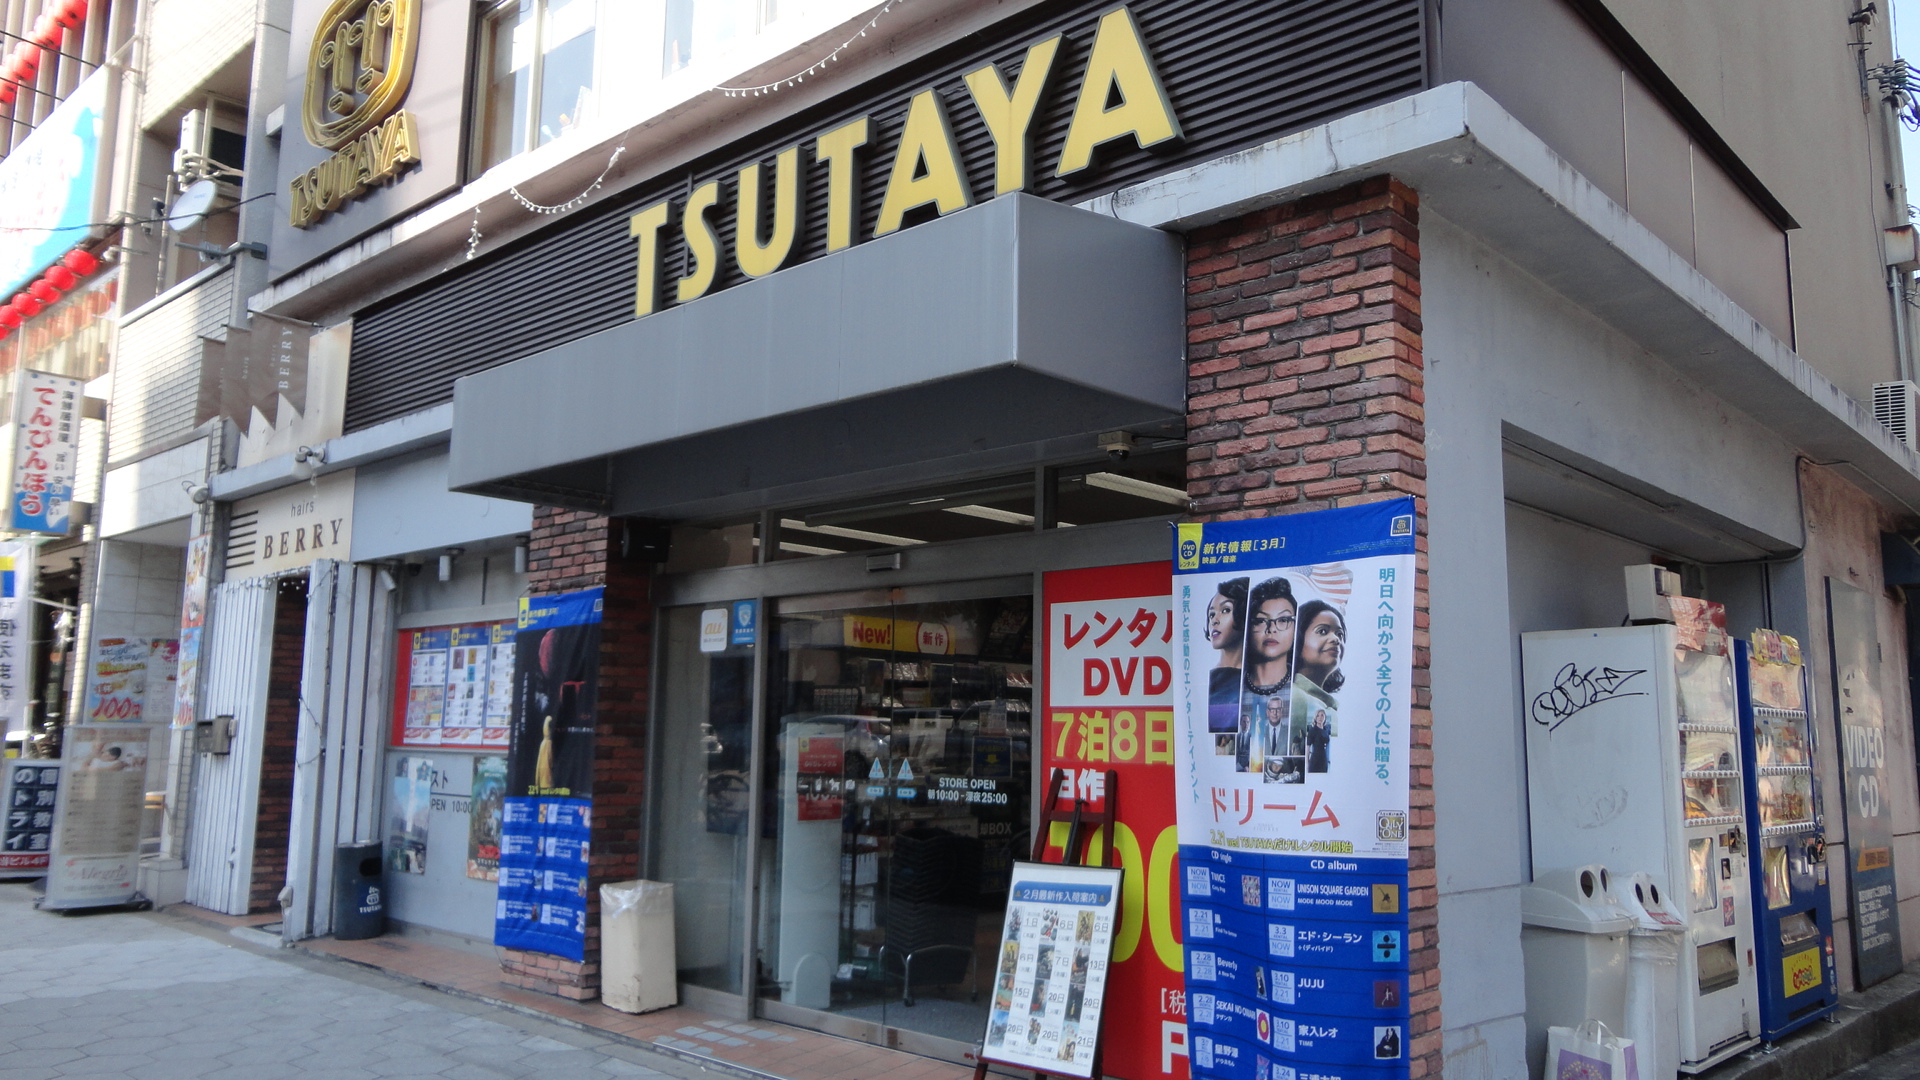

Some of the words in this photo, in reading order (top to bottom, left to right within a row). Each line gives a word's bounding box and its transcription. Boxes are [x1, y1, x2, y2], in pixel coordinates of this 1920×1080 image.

[629, 5, 1186, 319] TSUTAYA
[289, 108, 421, 230] TSUTAYA
[278, 326, 293, 389] BERRY
[290, 501, 315, 517] hairs
[262, 518, 343, 560] BERRY
[1202, 536, 1287, 555] 新作情報[3月]
[1180, 560, 1196, 568] レンタル
[852, 621, 892, 645] New!
[922, 631, 944, 646] 新作
[1083, 655, 1172, 696] DVD
[1051, 710, 1174, 765] 7泊8日
[1843, 724, 1885, 769] VIDEO
[938, 777, 968, 789] STORE
[969, 778, 996, 790] OPEN
[1857, 775, 1880, 819] CD
[431, 798, 446, 811] PEN
[1211, 786, 1341, 829] ドリーム
[1382, 829, 1403, 839] ONE
[1190, 868, 1207, 876] NOW
[1310, 860, 1326, 869] CD
[1327, 861, 1358, 871] album
[1271, 880, 1291, 889] NOW
[1297, 883, 1319, 894] UNISON
[1320, 884, 1344, 896] SQUARE
[1344, 886, 1369, 896] GARDEN
[1271, 895, 1291, 904] NOW
[1194, 910, 1208, 918] 2.21
[1094, 922, 1109, 933] 6日
[1274, 926, 1287, 935] 3.3
[1297, 930, 1363, 943] エド・シーラン
[1271, 942, 1291, 951] NOW
[1217, 957, 1238, 971] Beverly
[1274, 973, 1290, 983] 3.10
[1297, 978, 1325, 989] JUJU
[1048, 992, 1065, 1003] 20日
[1083, 998, 1101, 1009] 20日
[1216, 1000, 1234, 1012] SEKAI
[1042, 1030, 1059, 1041] 20日
[1298, 1024, 1339, 1038] 家入レオ
[1077, 1035, 1095, 1048] 21日
[1299, 1039, 1314, 1047] TIME
[1275, 1066, 1291, 1077] 3.24
